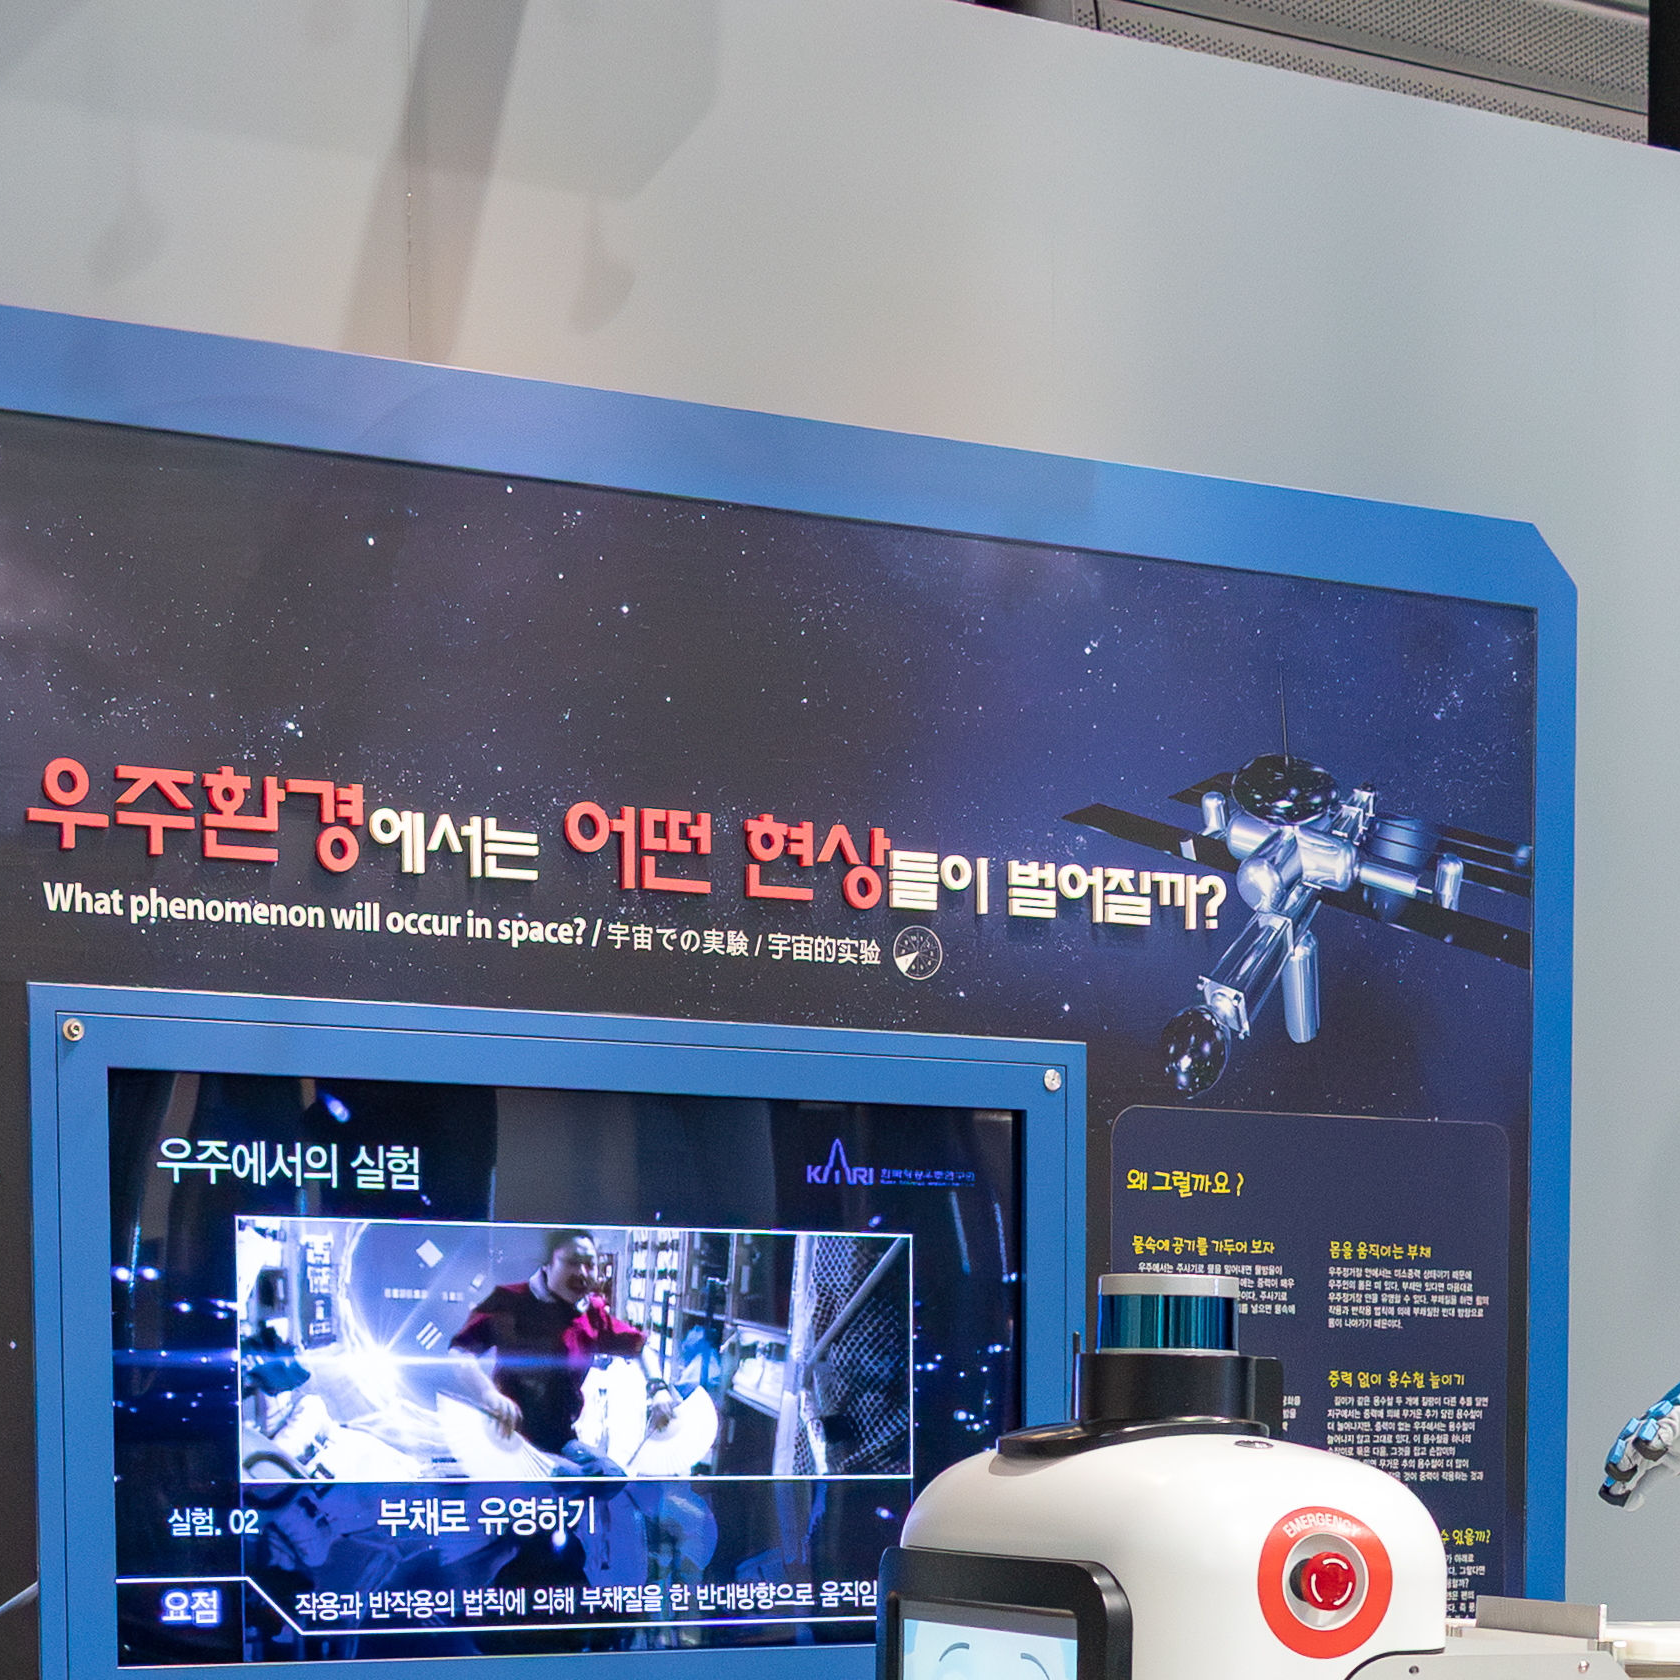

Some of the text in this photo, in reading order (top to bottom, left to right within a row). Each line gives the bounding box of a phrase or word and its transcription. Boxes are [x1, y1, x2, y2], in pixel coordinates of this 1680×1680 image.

[26, 757, 1228, 930] 우주환경에서는 어떤 현상들이 벌어질까?
[43, 881, 124, 916] What
[130, 887, 326, 929] phenomenon
[330, 902, 380, 932] will
[385, 911, 462, 937] occur
[466, 909, 492, 939] in
[497, 917, 587, 948] space?
[607, 922, 750, 957] 宇宙での実験
[768, 933, 882, 965] 宇宙的实验
[156, 1137, 420, 1190] 우주에서의 실험
[1126, 1169, 1148, 1191] 왜
[1132, 1235, 1275, 1256] 물속에 공기를 가두어 보자
[1329, 1240, 1432, 1261] 몸을 움직이는 부채
[1328, 1370, 1465, 1389] 중력 없이 용수철 늘이기
[167, 1507, 259, 1537] 실험. 02
[377, 1496, 595, 1536] 부채로 유영하기
[1282, 1512, 1361, 1538] EMERGENCY
[1452, 1527, 1491, 1546] 있을까?
[161, 1591, 219, 1623] 요점
[295, 1580, 877, 1621] 작용과 반작용의 법칙에 의해 부채질을 한 반대방향으로 움직임
